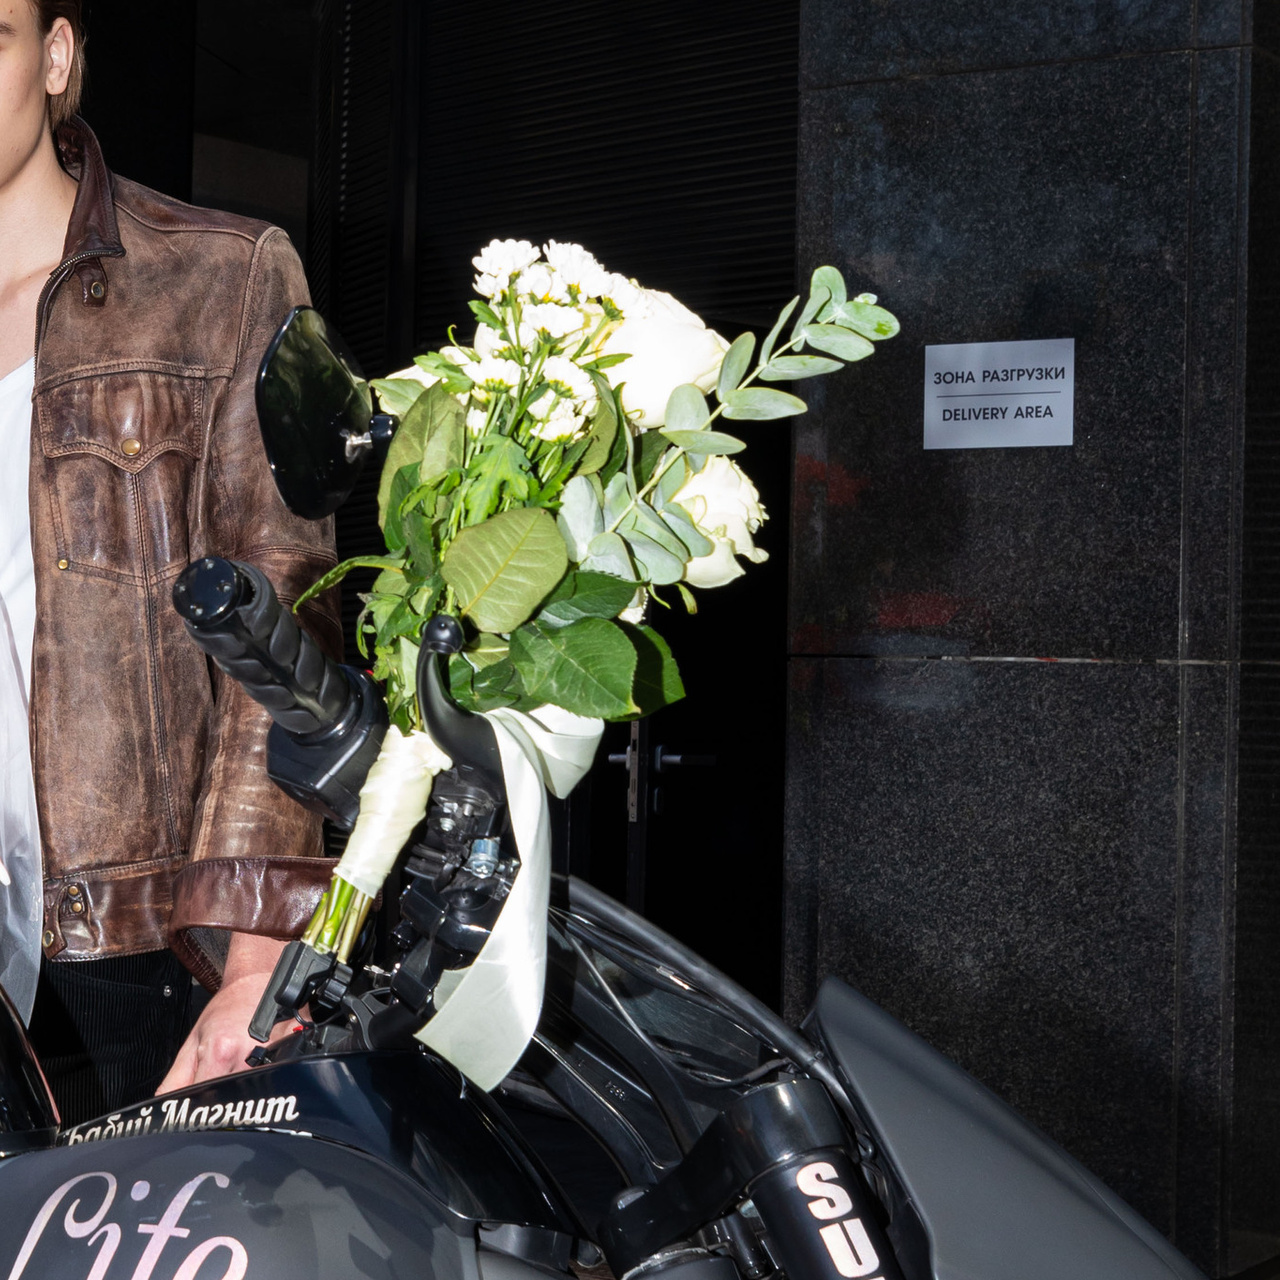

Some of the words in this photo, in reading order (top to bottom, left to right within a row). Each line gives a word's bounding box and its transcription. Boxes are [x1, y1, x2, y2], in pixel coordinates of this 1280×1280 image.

[933, 371, 976, 385] ЗОНА
[982, 367, 1065, 382] РАЗГРУЗКИ
[942, 406, 1008, 421] DELIVERY
[1013, 405, 1054, 419] AREA
[155, 1095, 300, 1132] Магнит
